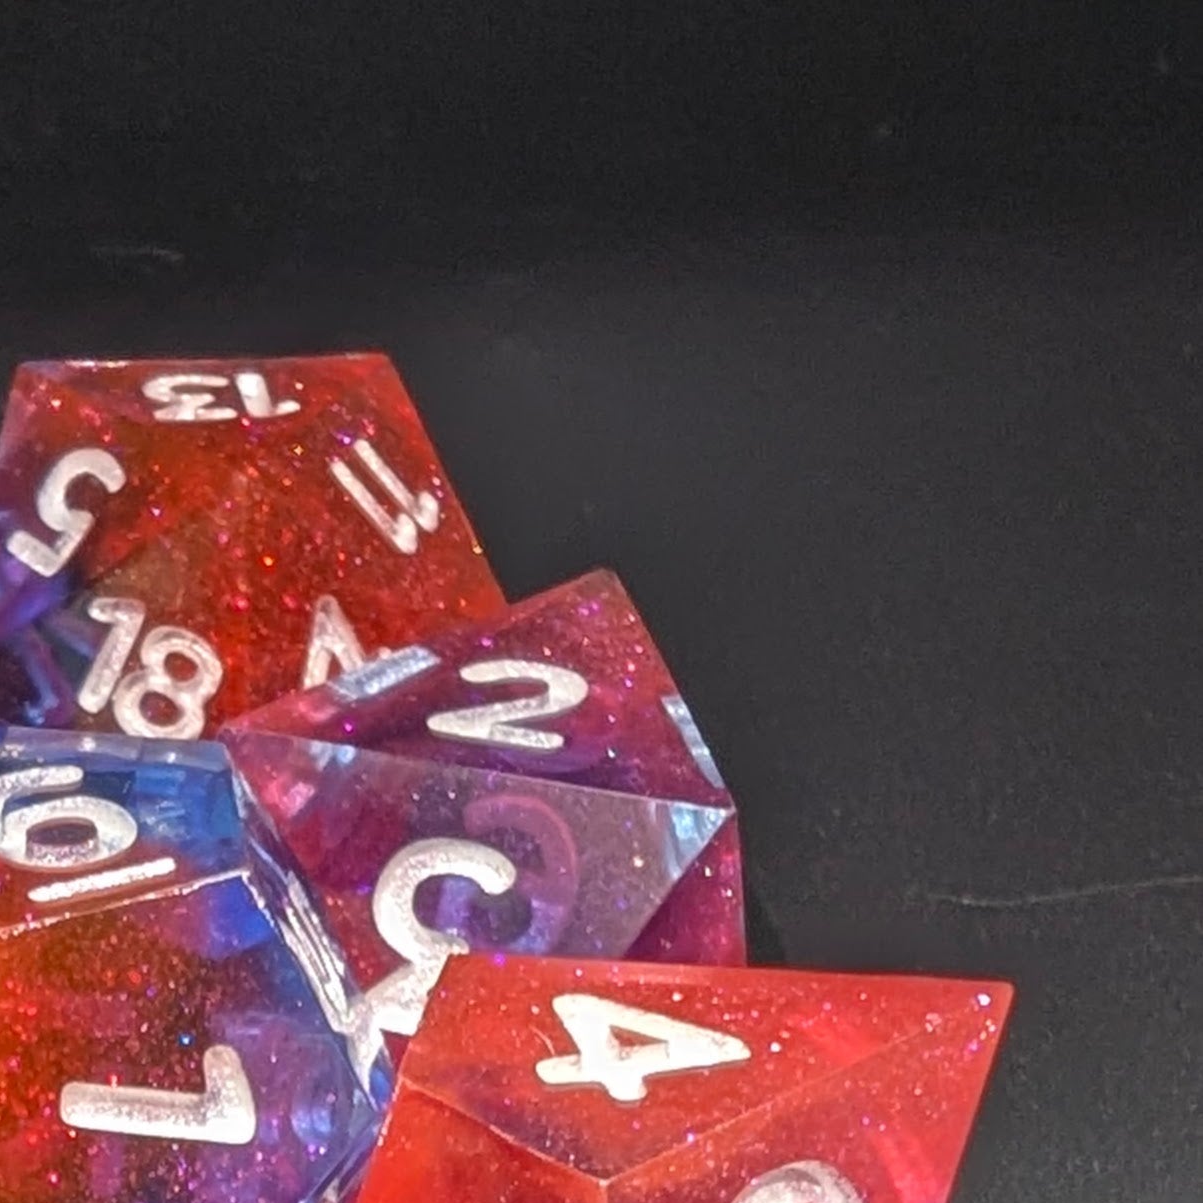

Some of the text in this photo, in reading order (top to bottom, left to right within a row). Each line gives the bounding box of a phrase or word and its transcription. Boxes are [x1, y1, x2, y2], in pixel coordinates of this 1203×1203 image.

[141, 371, 302, 422] 13
[5, 447, 127, 578] 5
[327, 437, 440, 556] 11
[77, 595, 224, 741] 18
[426, 658, 590, 751] 2
[534, 992, 753, 1102] 4
